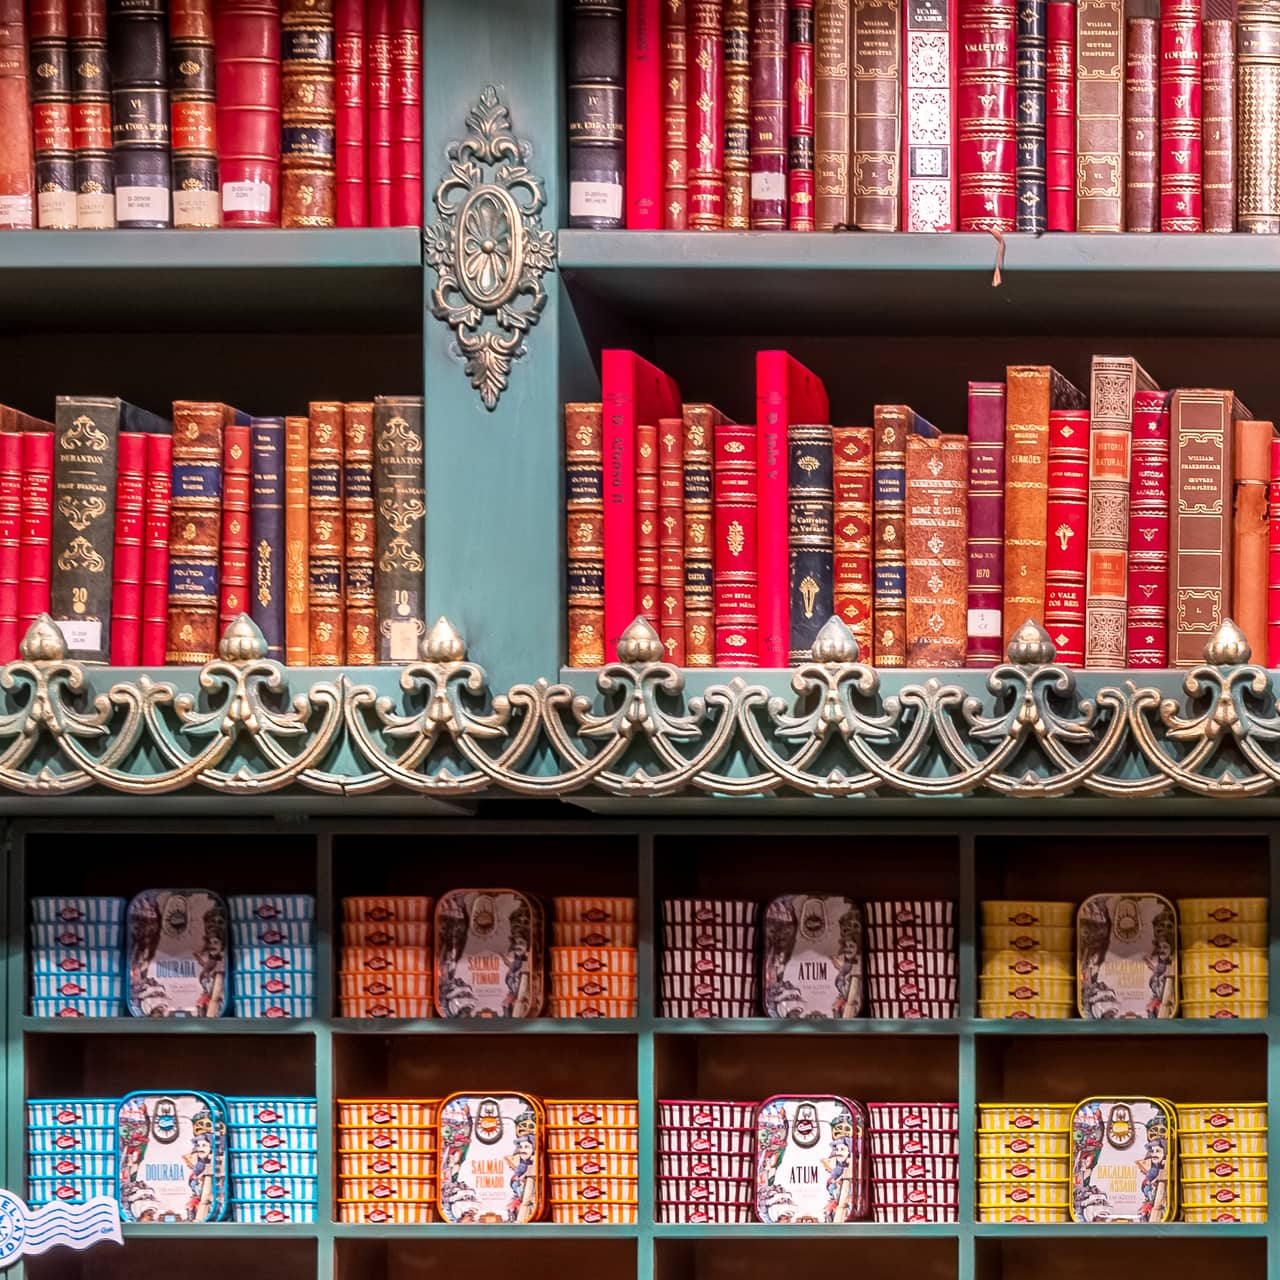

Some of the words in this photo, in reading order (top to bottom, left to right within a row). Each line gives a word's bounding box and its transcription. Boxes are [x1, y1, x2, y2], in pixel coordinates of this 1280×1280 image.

[73, 588, 87, 602] 20
[394, 590, 408, 604] 10
[798, 962, 827, 981] ATUM
[145, 1164, 184, 1181] DOURADA
[471, 1160, 503, 1174] SALMÃO
[475, 1175, 504, 1188] FUMADO
[790, 1166, 818, 1184] ATUM
